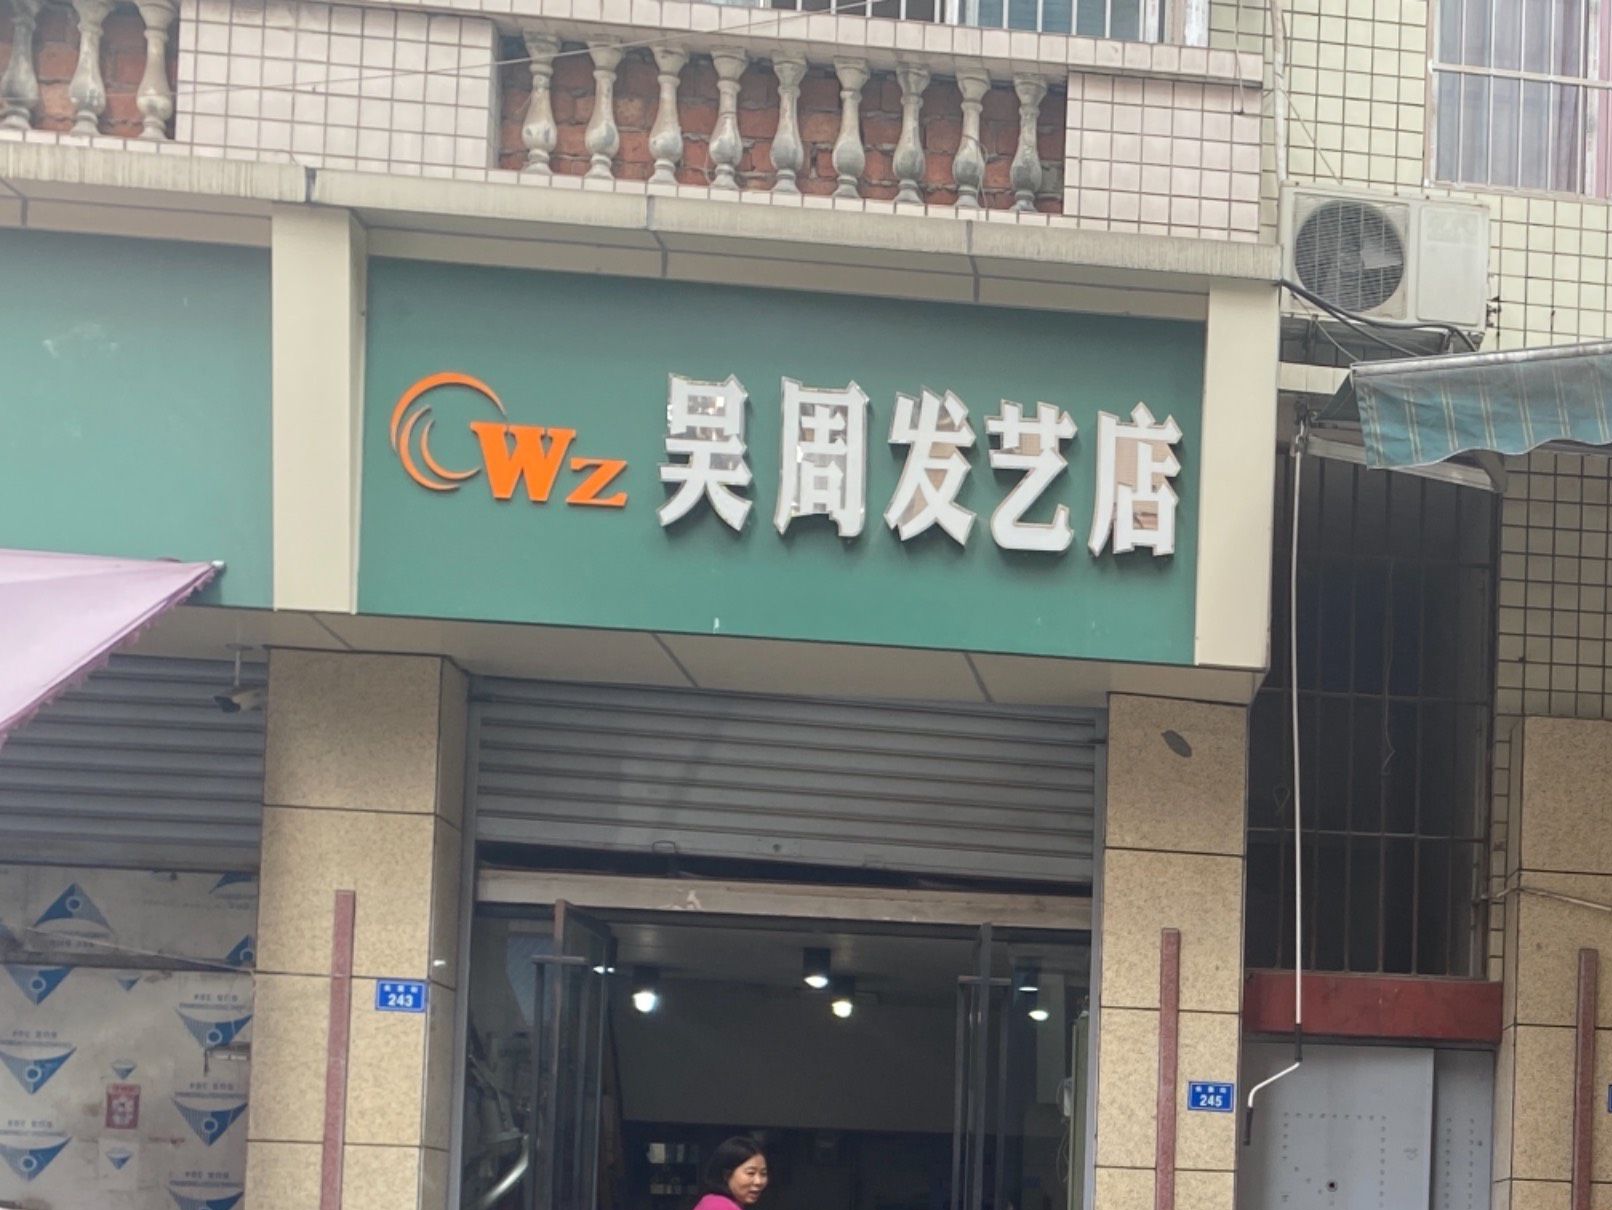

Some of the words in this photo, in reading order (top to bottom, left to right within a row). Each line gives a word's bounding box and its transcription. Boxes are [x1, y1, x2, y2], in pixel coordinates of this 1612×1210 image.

[657, 372, 1183, 557] 吴周发艺店
[387, 993, 414, 1007] 243
[1199, 1093, 1223, 1107] 245
